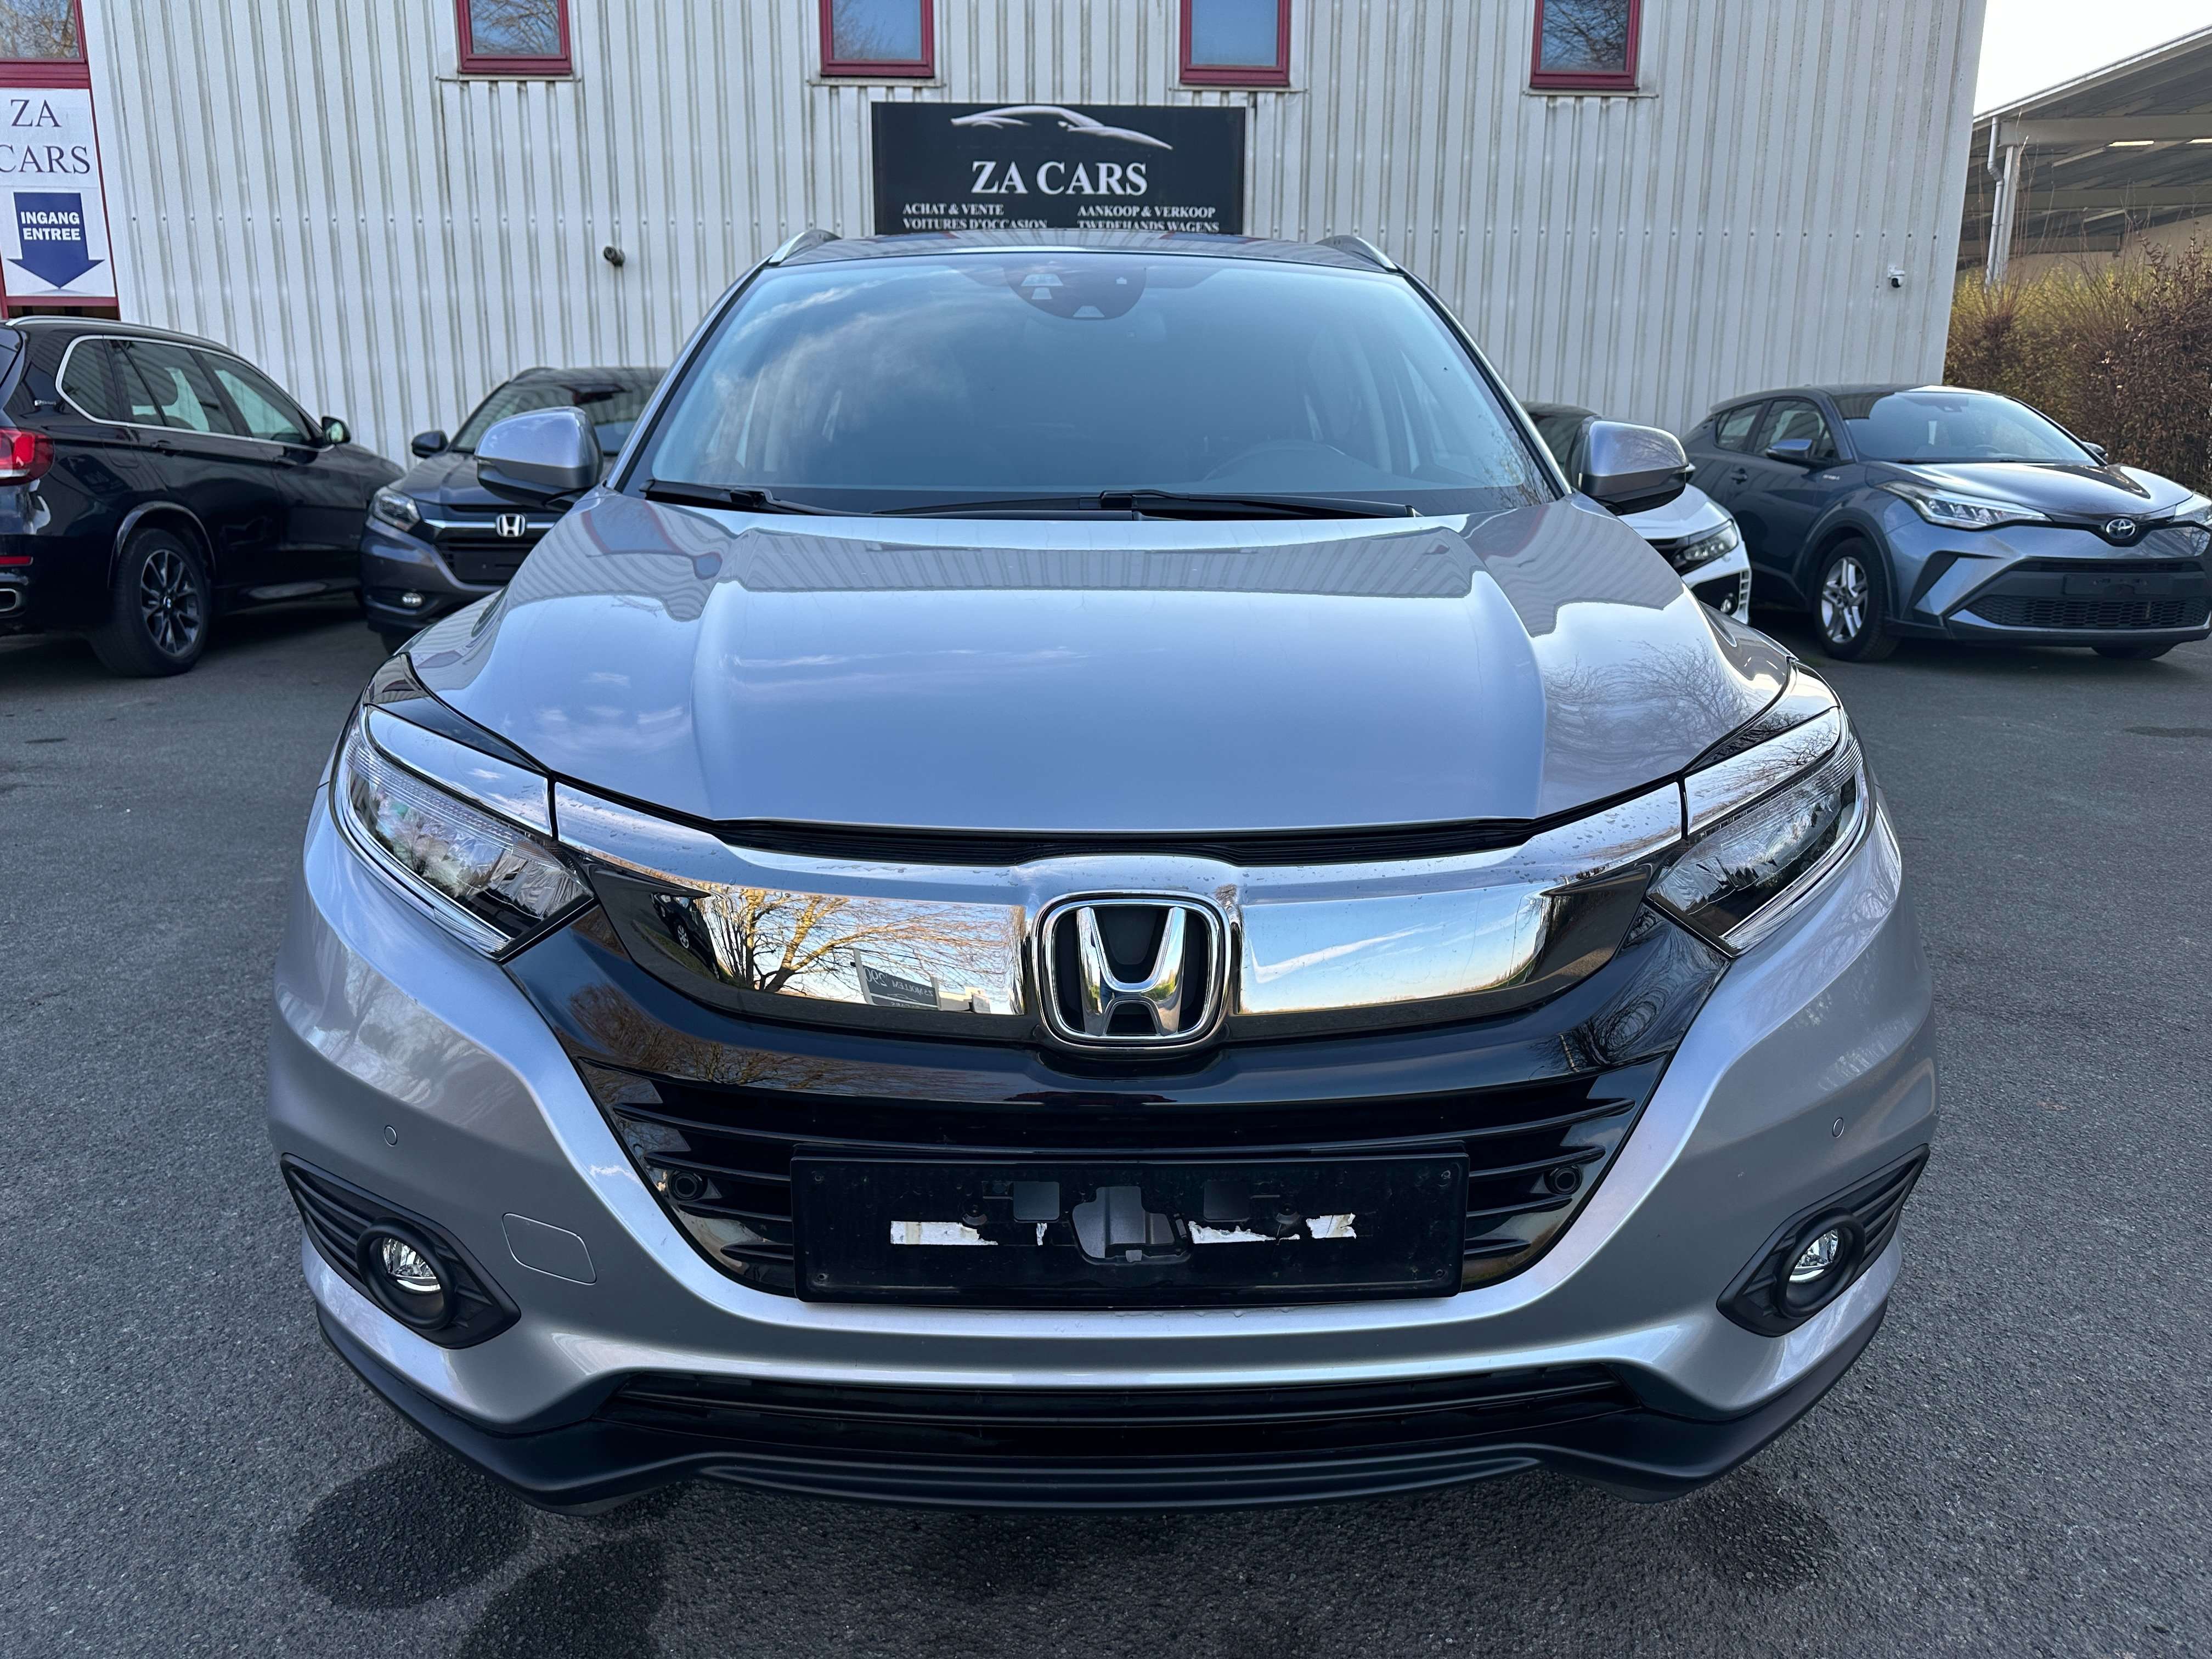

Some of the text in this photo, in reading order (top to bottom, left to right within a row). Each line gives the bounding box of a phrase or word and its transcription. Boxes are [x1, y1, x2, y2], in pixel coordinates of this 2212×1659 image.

[10, 99, 62, 127] ZA
[0, 144, 90, 174] CARS
[971, 161, 1148, 196] ZA CARS
[902, 203, 1005, 216] ACHAT & VENTE
[1077, 205, 1216, 218] AANKOOP & VERKOOP
[20, 211, 80, 224] INGANG
[902, 218, 967, 230] VOITURES
[1166, 221, 1220, 233] WAGENS
[23, 228, 81, 241] ENTREE
